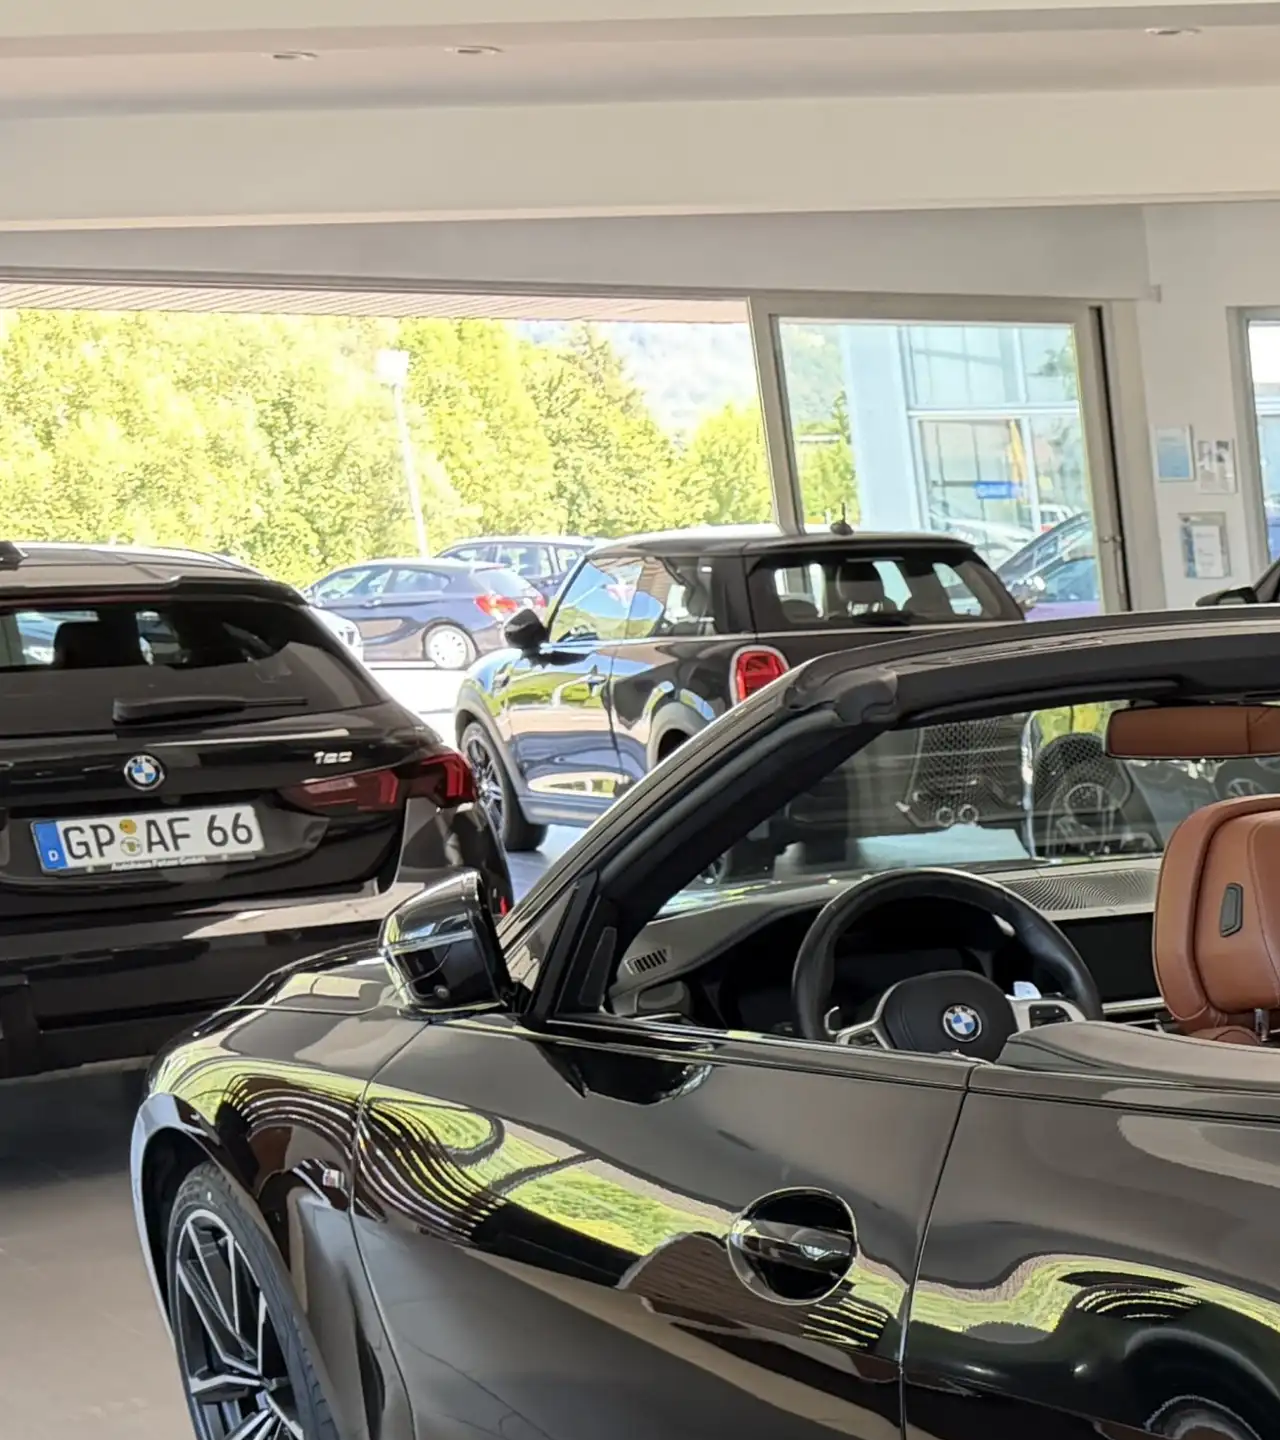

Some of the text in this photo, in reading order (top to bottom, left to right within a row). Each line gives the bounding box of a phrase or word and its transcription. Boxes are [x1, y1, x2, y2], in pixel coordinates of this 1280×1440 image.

[62, 823, 116, 860] GP
[145, 816, 191, 853] AF
[206, 812, 254, 847] 66
